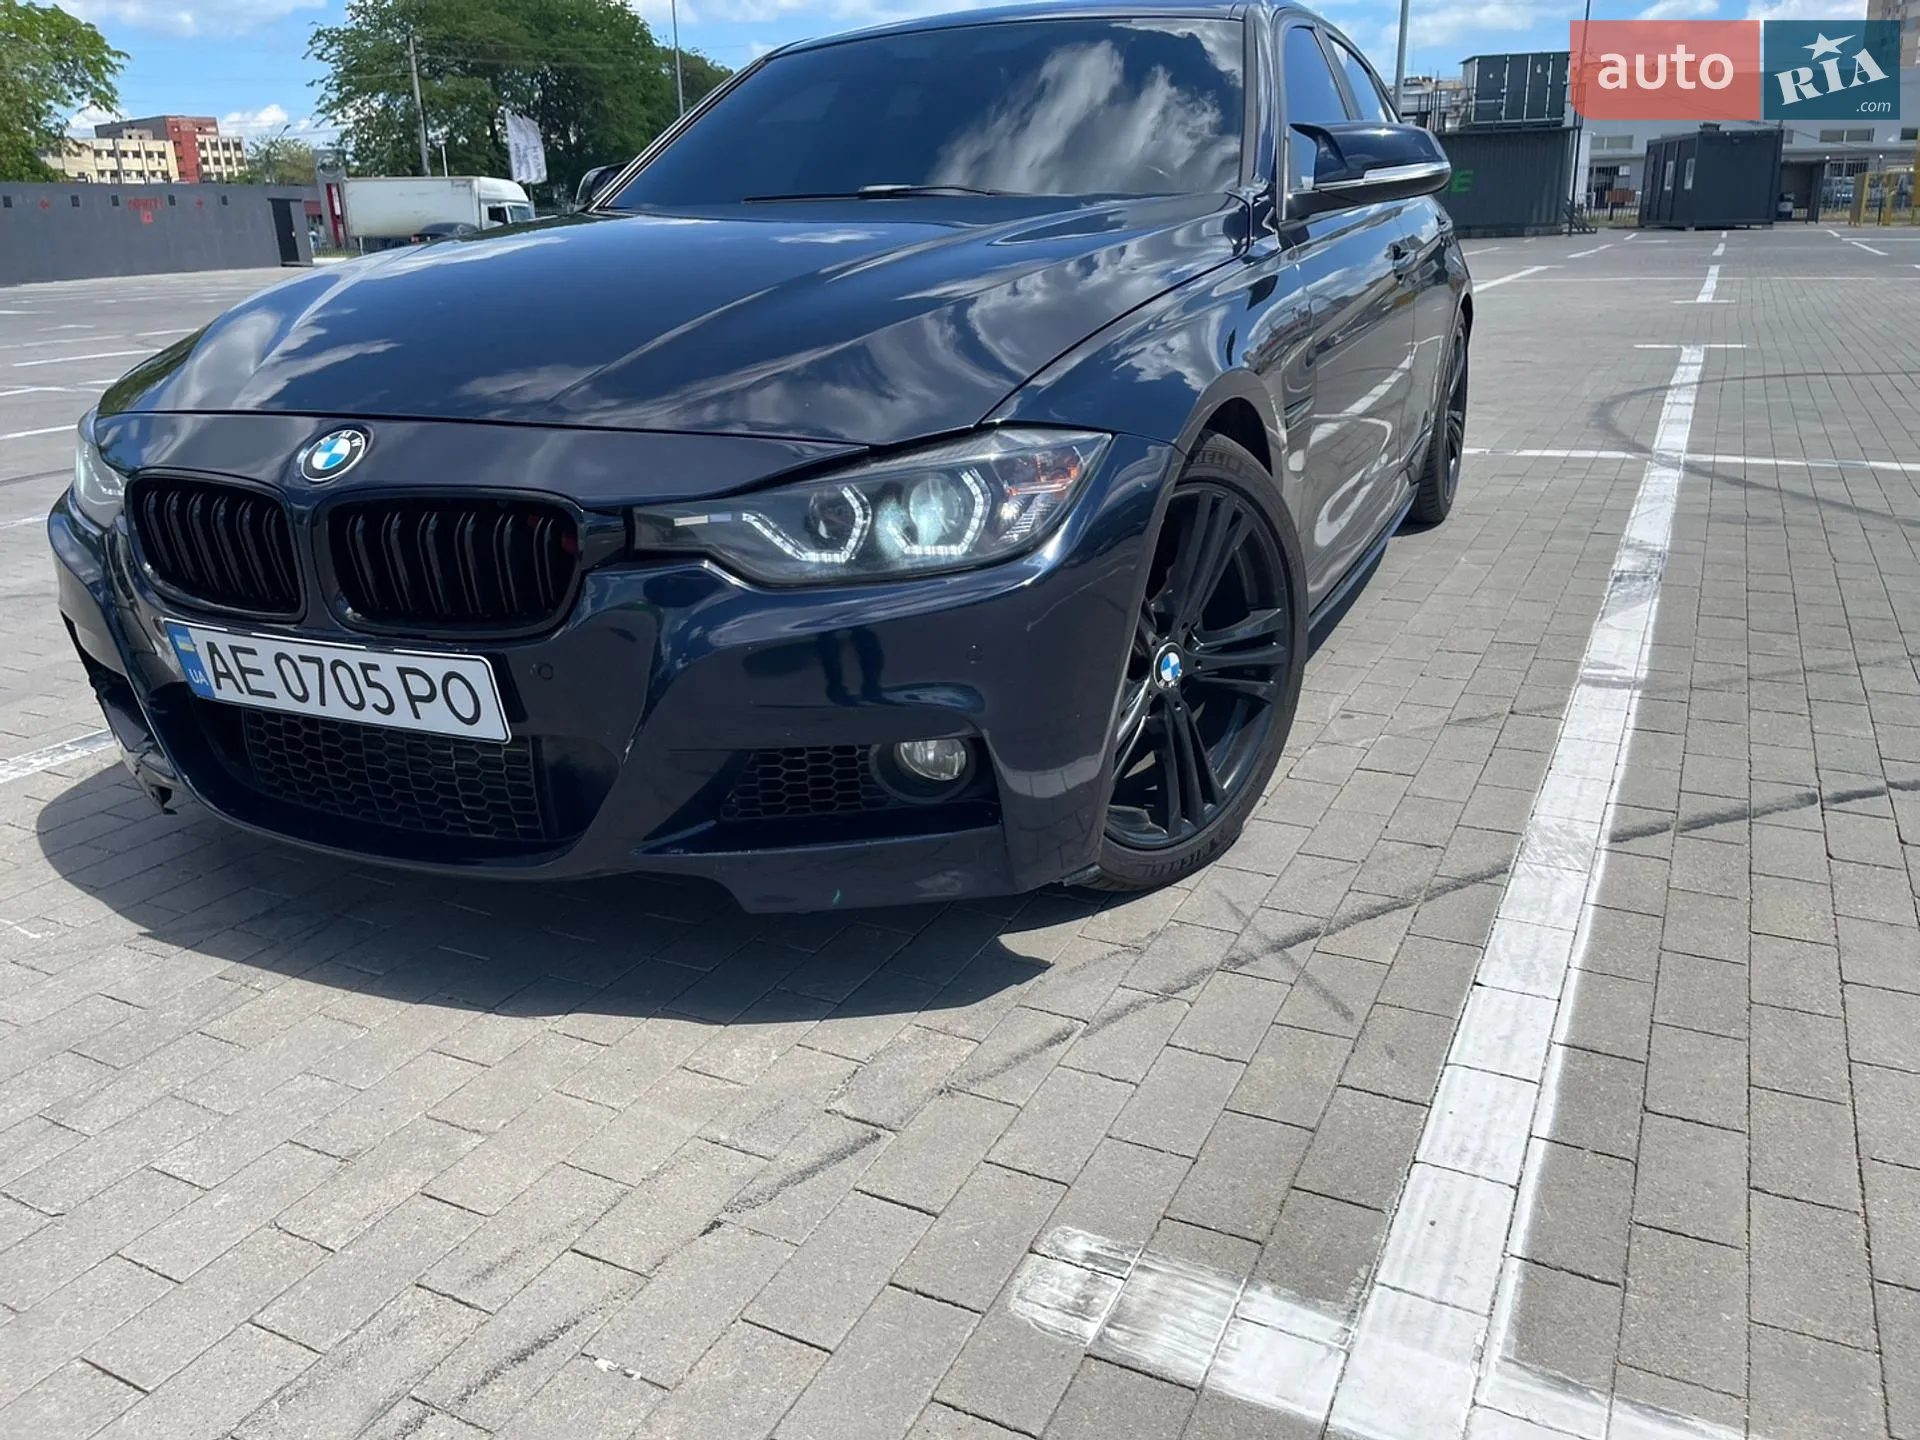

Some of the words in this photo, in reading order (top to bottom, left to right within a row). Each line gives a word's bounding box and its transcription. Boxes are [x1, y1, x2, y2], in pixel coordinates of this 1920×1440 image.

[190, 667, 210, 686] UA
[206, 641, 277, 699] AE
[274, 651, 395, 716] 0705
[396, 666, 481, 726] PO
